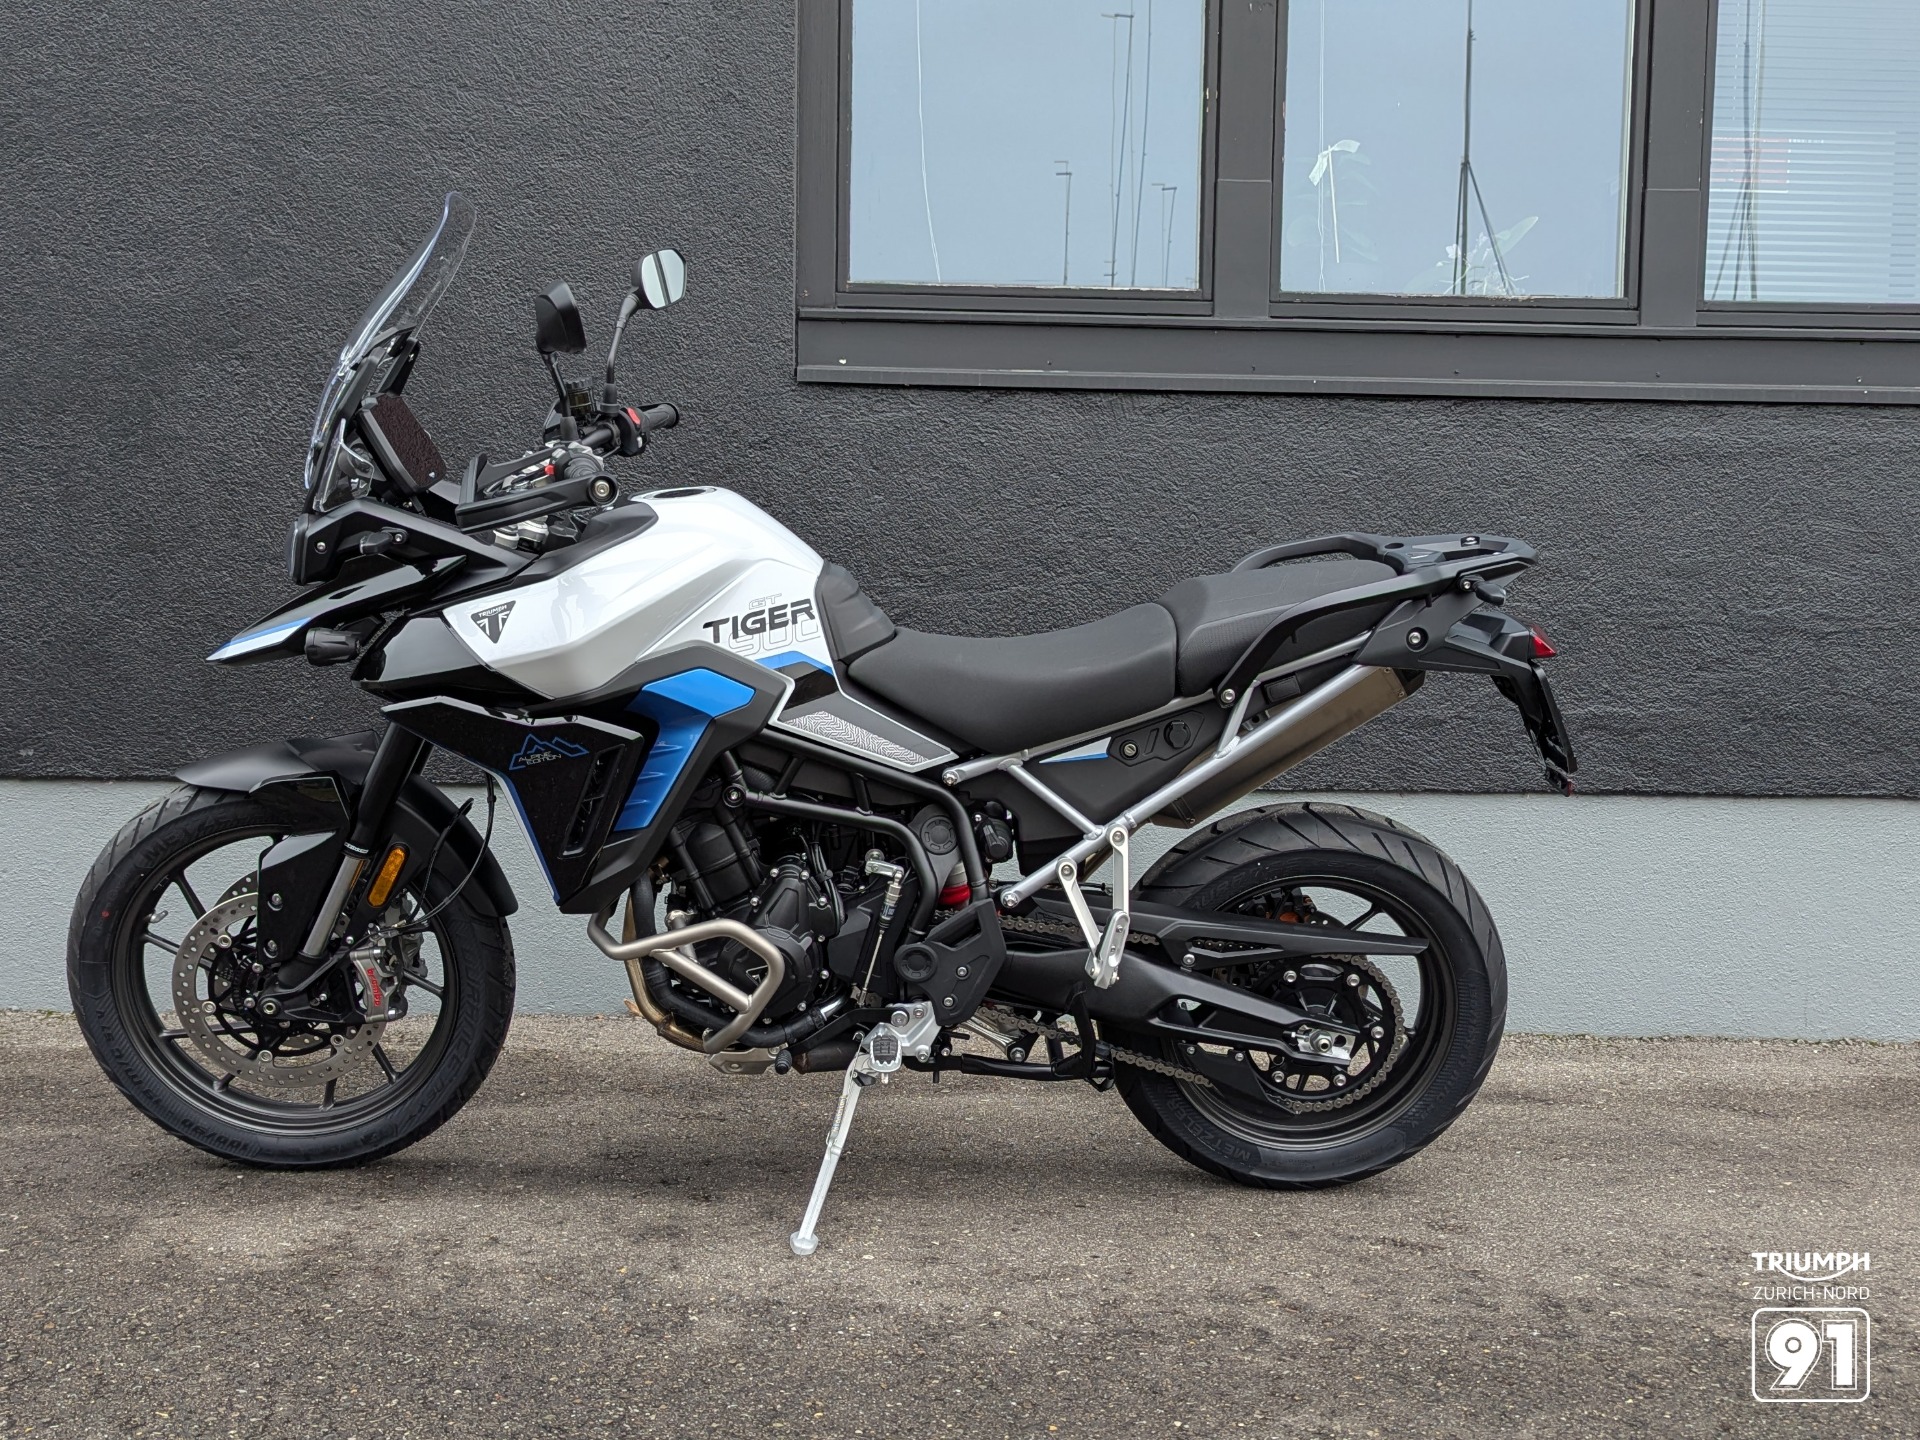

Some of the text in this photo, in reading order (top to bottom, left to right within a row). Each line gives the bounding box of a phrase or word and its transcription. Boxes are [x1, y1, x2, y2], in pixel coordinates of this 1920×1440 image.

[478, 604, 507, 618] TRIUMPH
[749, 593, 782, 610] GT
[703, 598, 816, 644] TIGER
[366, 968, 383, 1007] brembo
